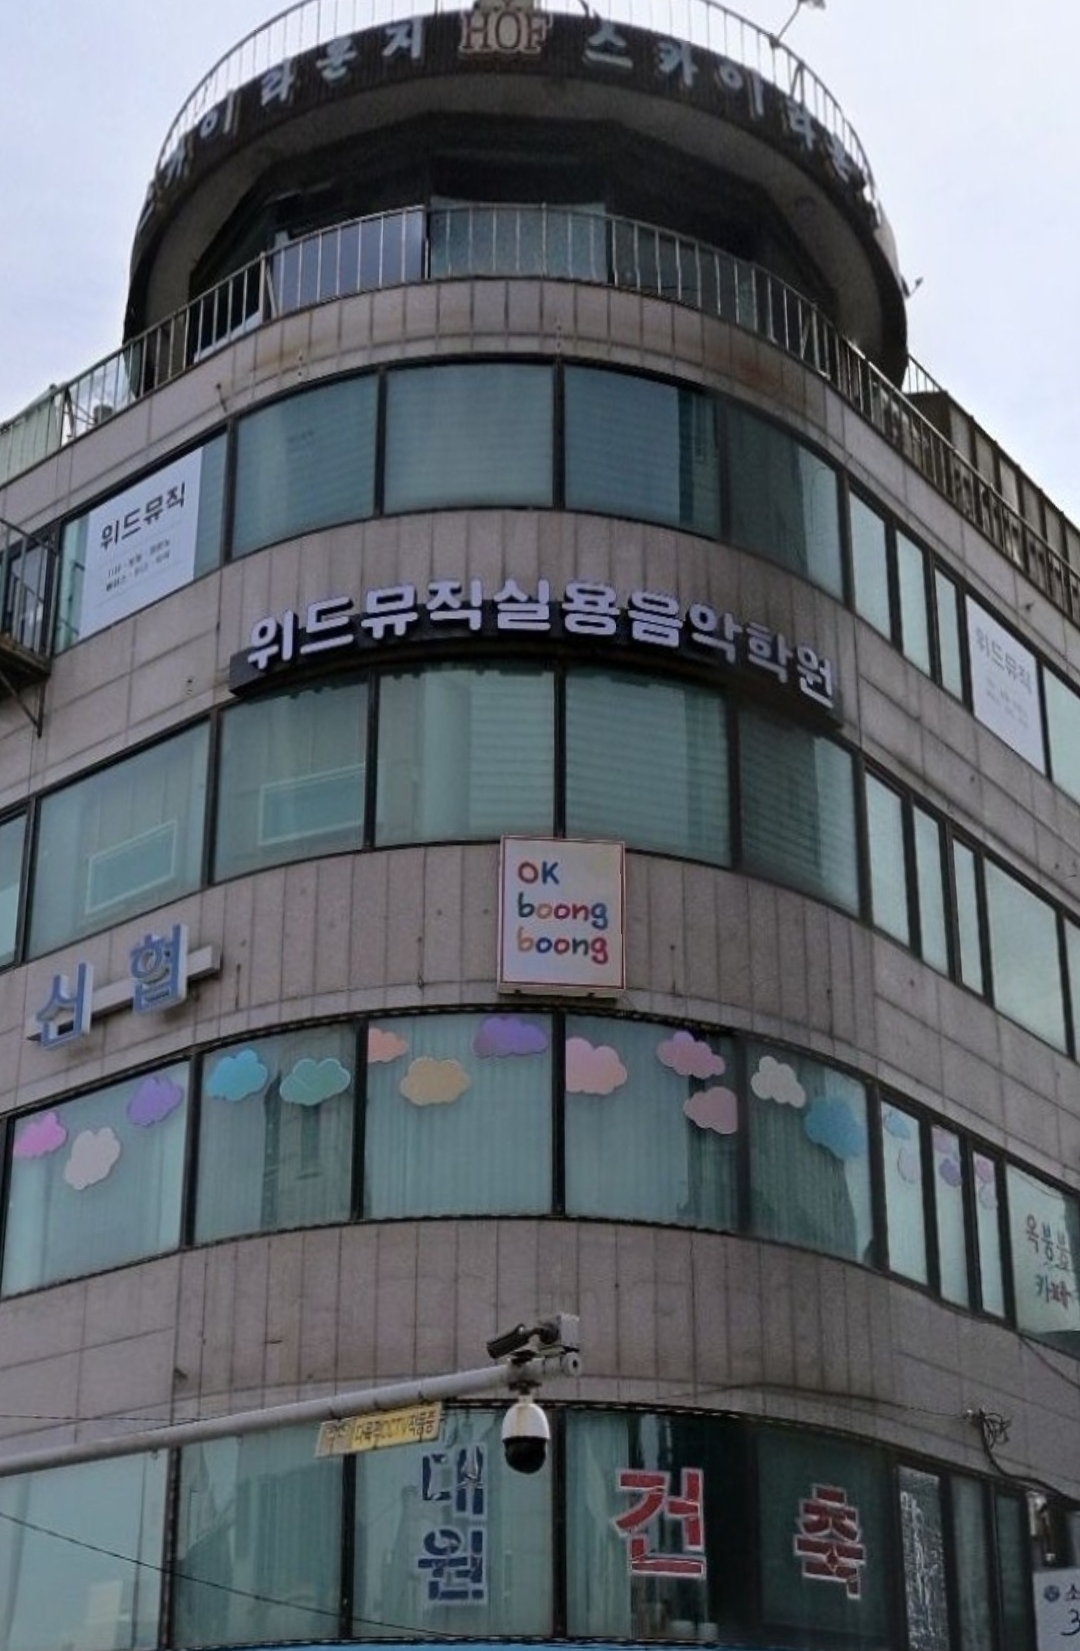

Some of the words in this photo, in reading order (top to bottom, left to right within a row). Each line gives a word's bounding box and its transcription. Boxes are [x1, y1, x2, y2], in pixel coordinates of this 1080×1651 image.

[457, 10, 554, 56] HOF
[101, 481, 186, 550] 위드뮤직
[975, 626, 1032, 694] 위드뮤직
[517, 860, 560, 886] OK
[517, 891, 609, 931] boong
[516, 925, 610, 966] boong
[36, 922, 190, 1051] 신협
